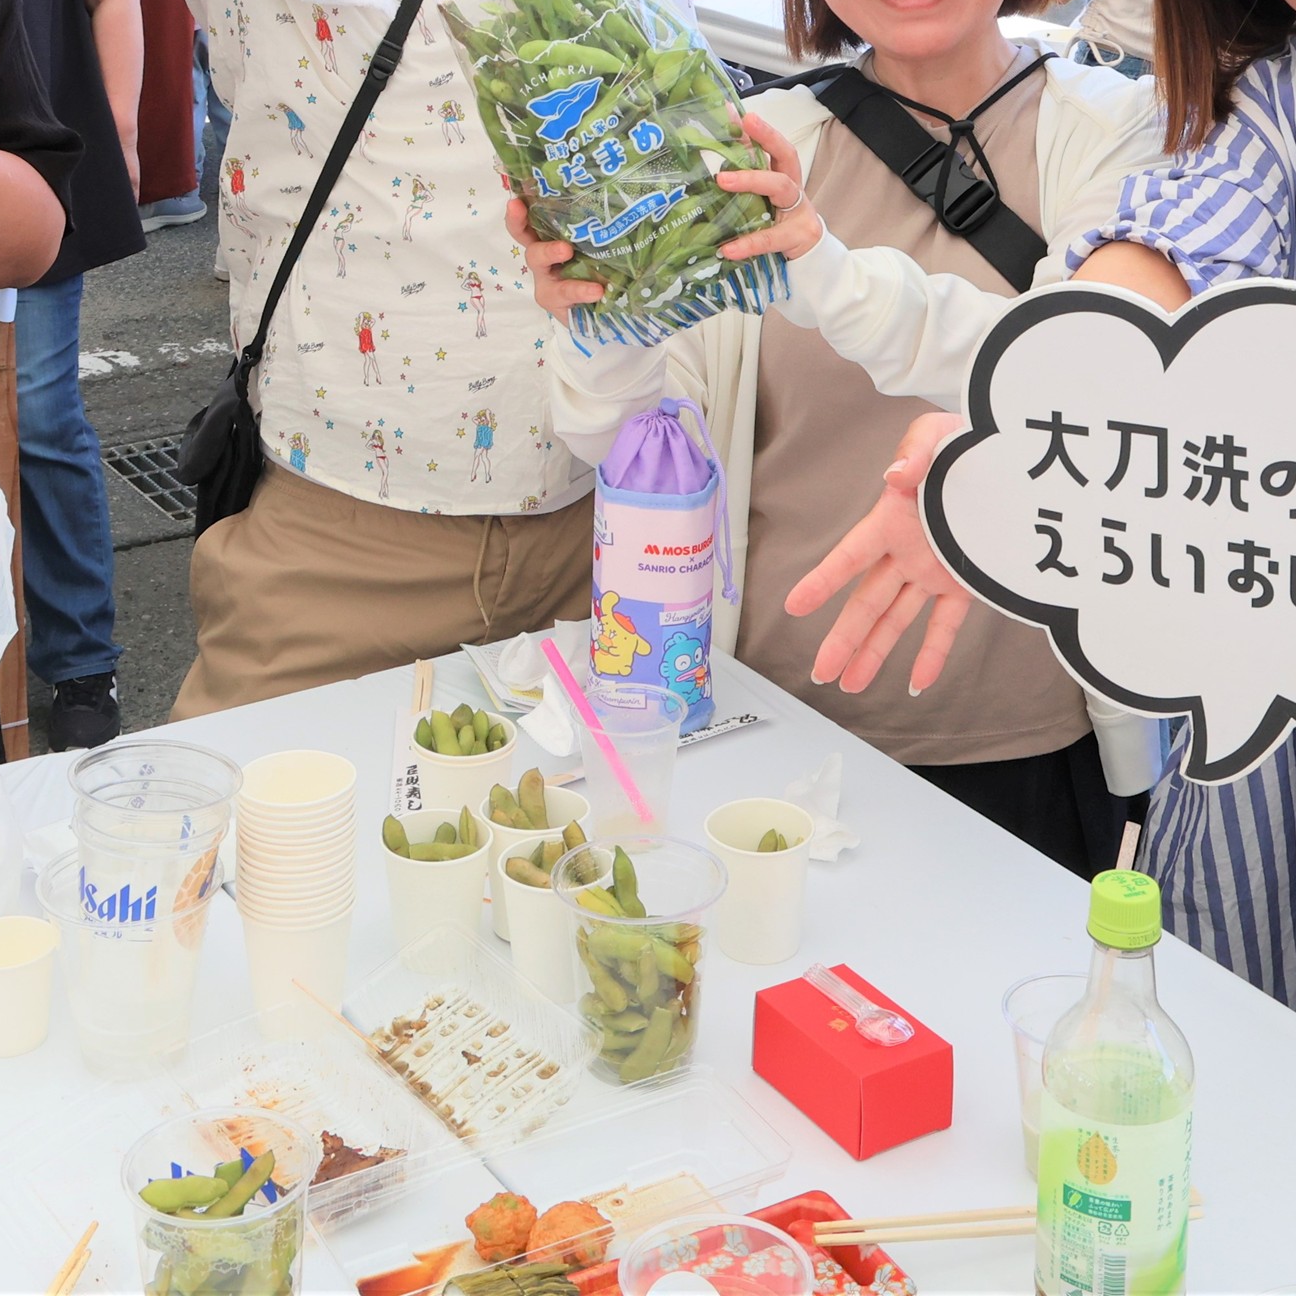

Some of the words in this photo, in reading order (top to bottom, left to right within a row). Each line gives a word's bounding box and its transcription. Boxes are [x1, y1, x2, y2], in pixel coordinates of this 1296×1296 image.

[519, 64, 594, 97] TACHIARAI
[612, 245, 633, 258] FARM
[633, 232, 659, 252] HOUSE
[659, 224, 671, 236] BY
[662, 545, 691, 556] MOS
[637, 562, 676, 574] SANRIO
[79, 865, 158, 923] sahi
